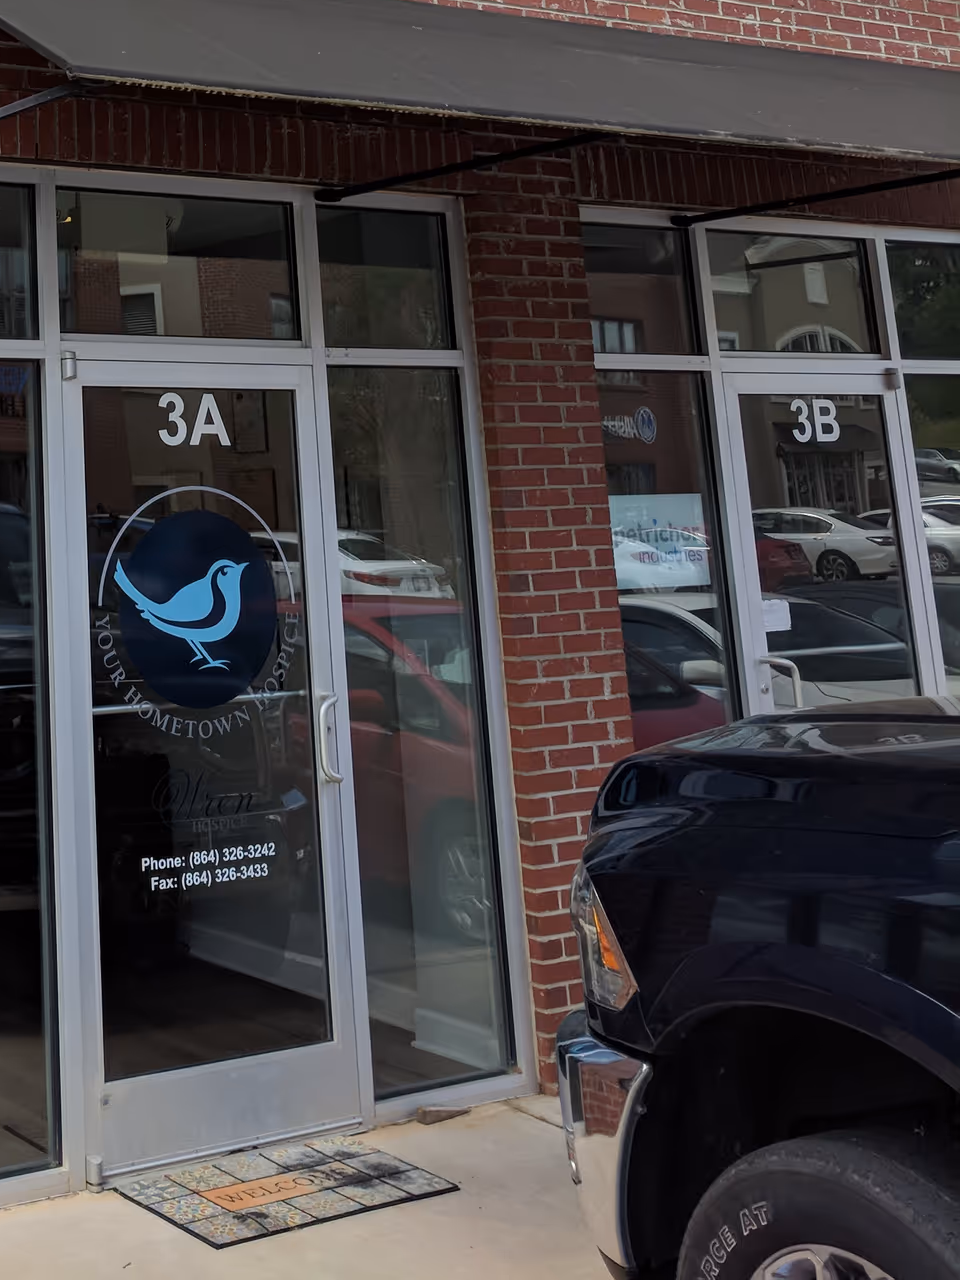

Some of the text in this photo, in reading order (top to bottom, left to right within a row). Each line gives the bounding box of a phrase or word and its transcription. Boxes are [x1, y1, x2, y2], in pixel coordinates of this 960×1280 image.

[157, 391, 232, 447] 3A
[790, 398, 841, 443] 3B
[94, 611, 300, 739] YOUR HOMETOWN HOSPICE
[141, 842, 276, 872] Phone: (864) 326-3242
[150, 863, 269, 892] Fax: (864) 326-3433
[215, 1166, 347, 1204] WELCOME
[697, 1201, 768, 1280] RCE AT
